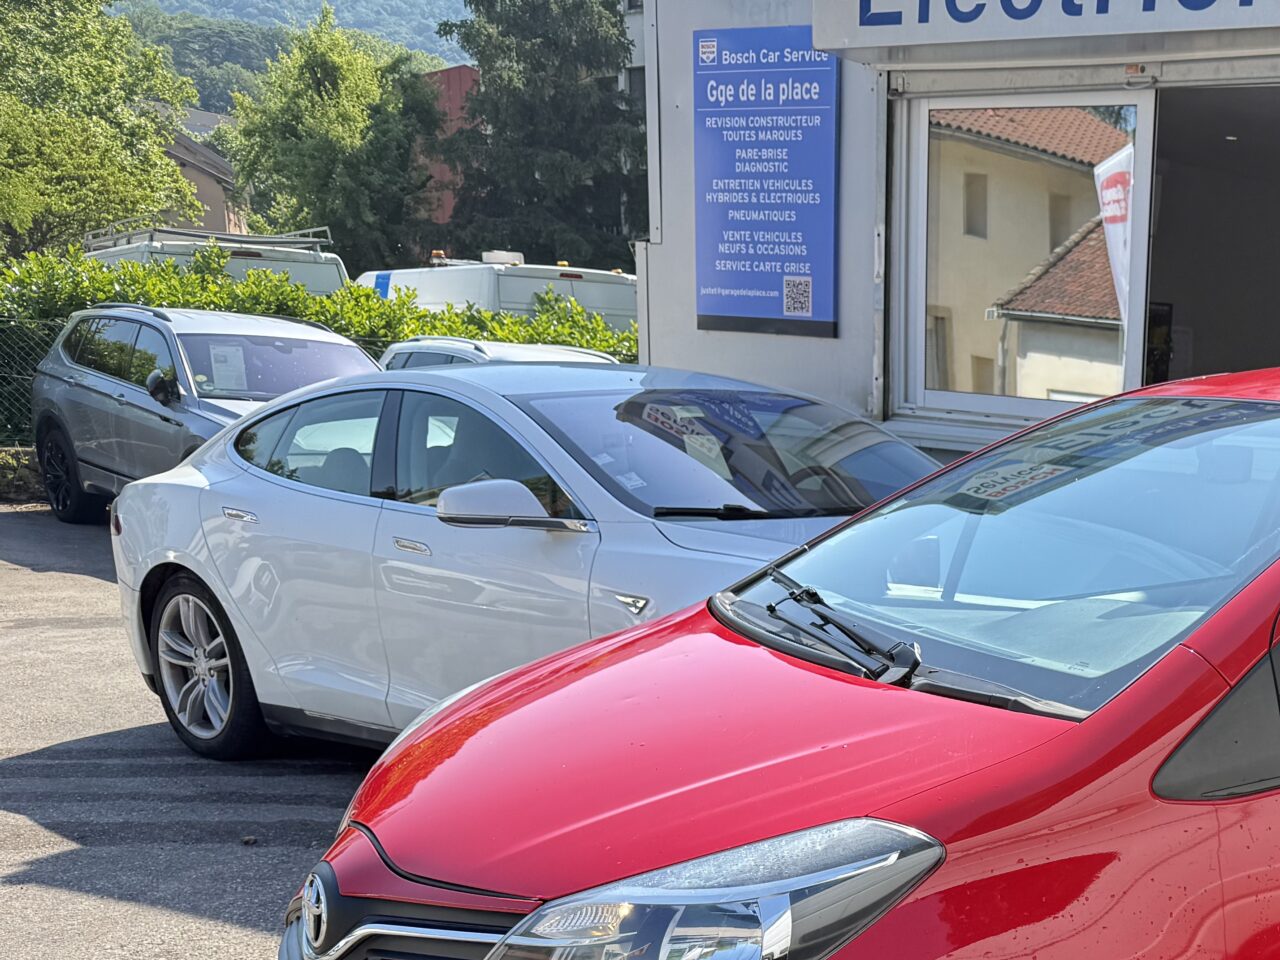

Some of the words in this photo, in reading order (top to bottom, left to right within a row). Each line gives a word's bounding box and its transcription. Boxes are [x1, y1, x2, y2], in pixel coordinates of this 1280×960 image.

[722, 50, 756, 64] Bosch
[760, 49, 780, 63] Car
[783, 48, 829, 62] Service
[707, 80, 734, 106] Gge
[739, 78, 756, 101] de
[761, 78, 774, 100] la
[779, 77, 820, 105] place
[705, 117, 746, 128] REVISION
[748, 116, 821, 127] CONSTRUCTEUR
[722, 131, 756, 141] TOUTES
[758, 130, 803, 141] MARQUES
[735, 149, 788, 160] PARE-BRISE
[735, 162, 789, 173] DIAGNOSTIC
[712, 180, 761, 190] ENTRETIEN
[763, 180, 813, 190] VEHICULES
[706, 192, 749, 203] HYBRIDES
[750, 193, 757, 204] &
[759, 193, 821, 204] ELECTRIQUES
[728, 210, 797, 221] PNEUMATIQUES
[722, 231, 751, 241] VENTE
[753, 231, 803, 242] VEHICULES
[718, 243, 746, 254] NEUFS
[748, 244, 755, 255] &
[756, 244, 807, 256] OCCASIONS
[715, 260, 751, 271] SERVICE
[752, 261, 782, 273] CARTE
[783, 262, 811, 274] GRISE
